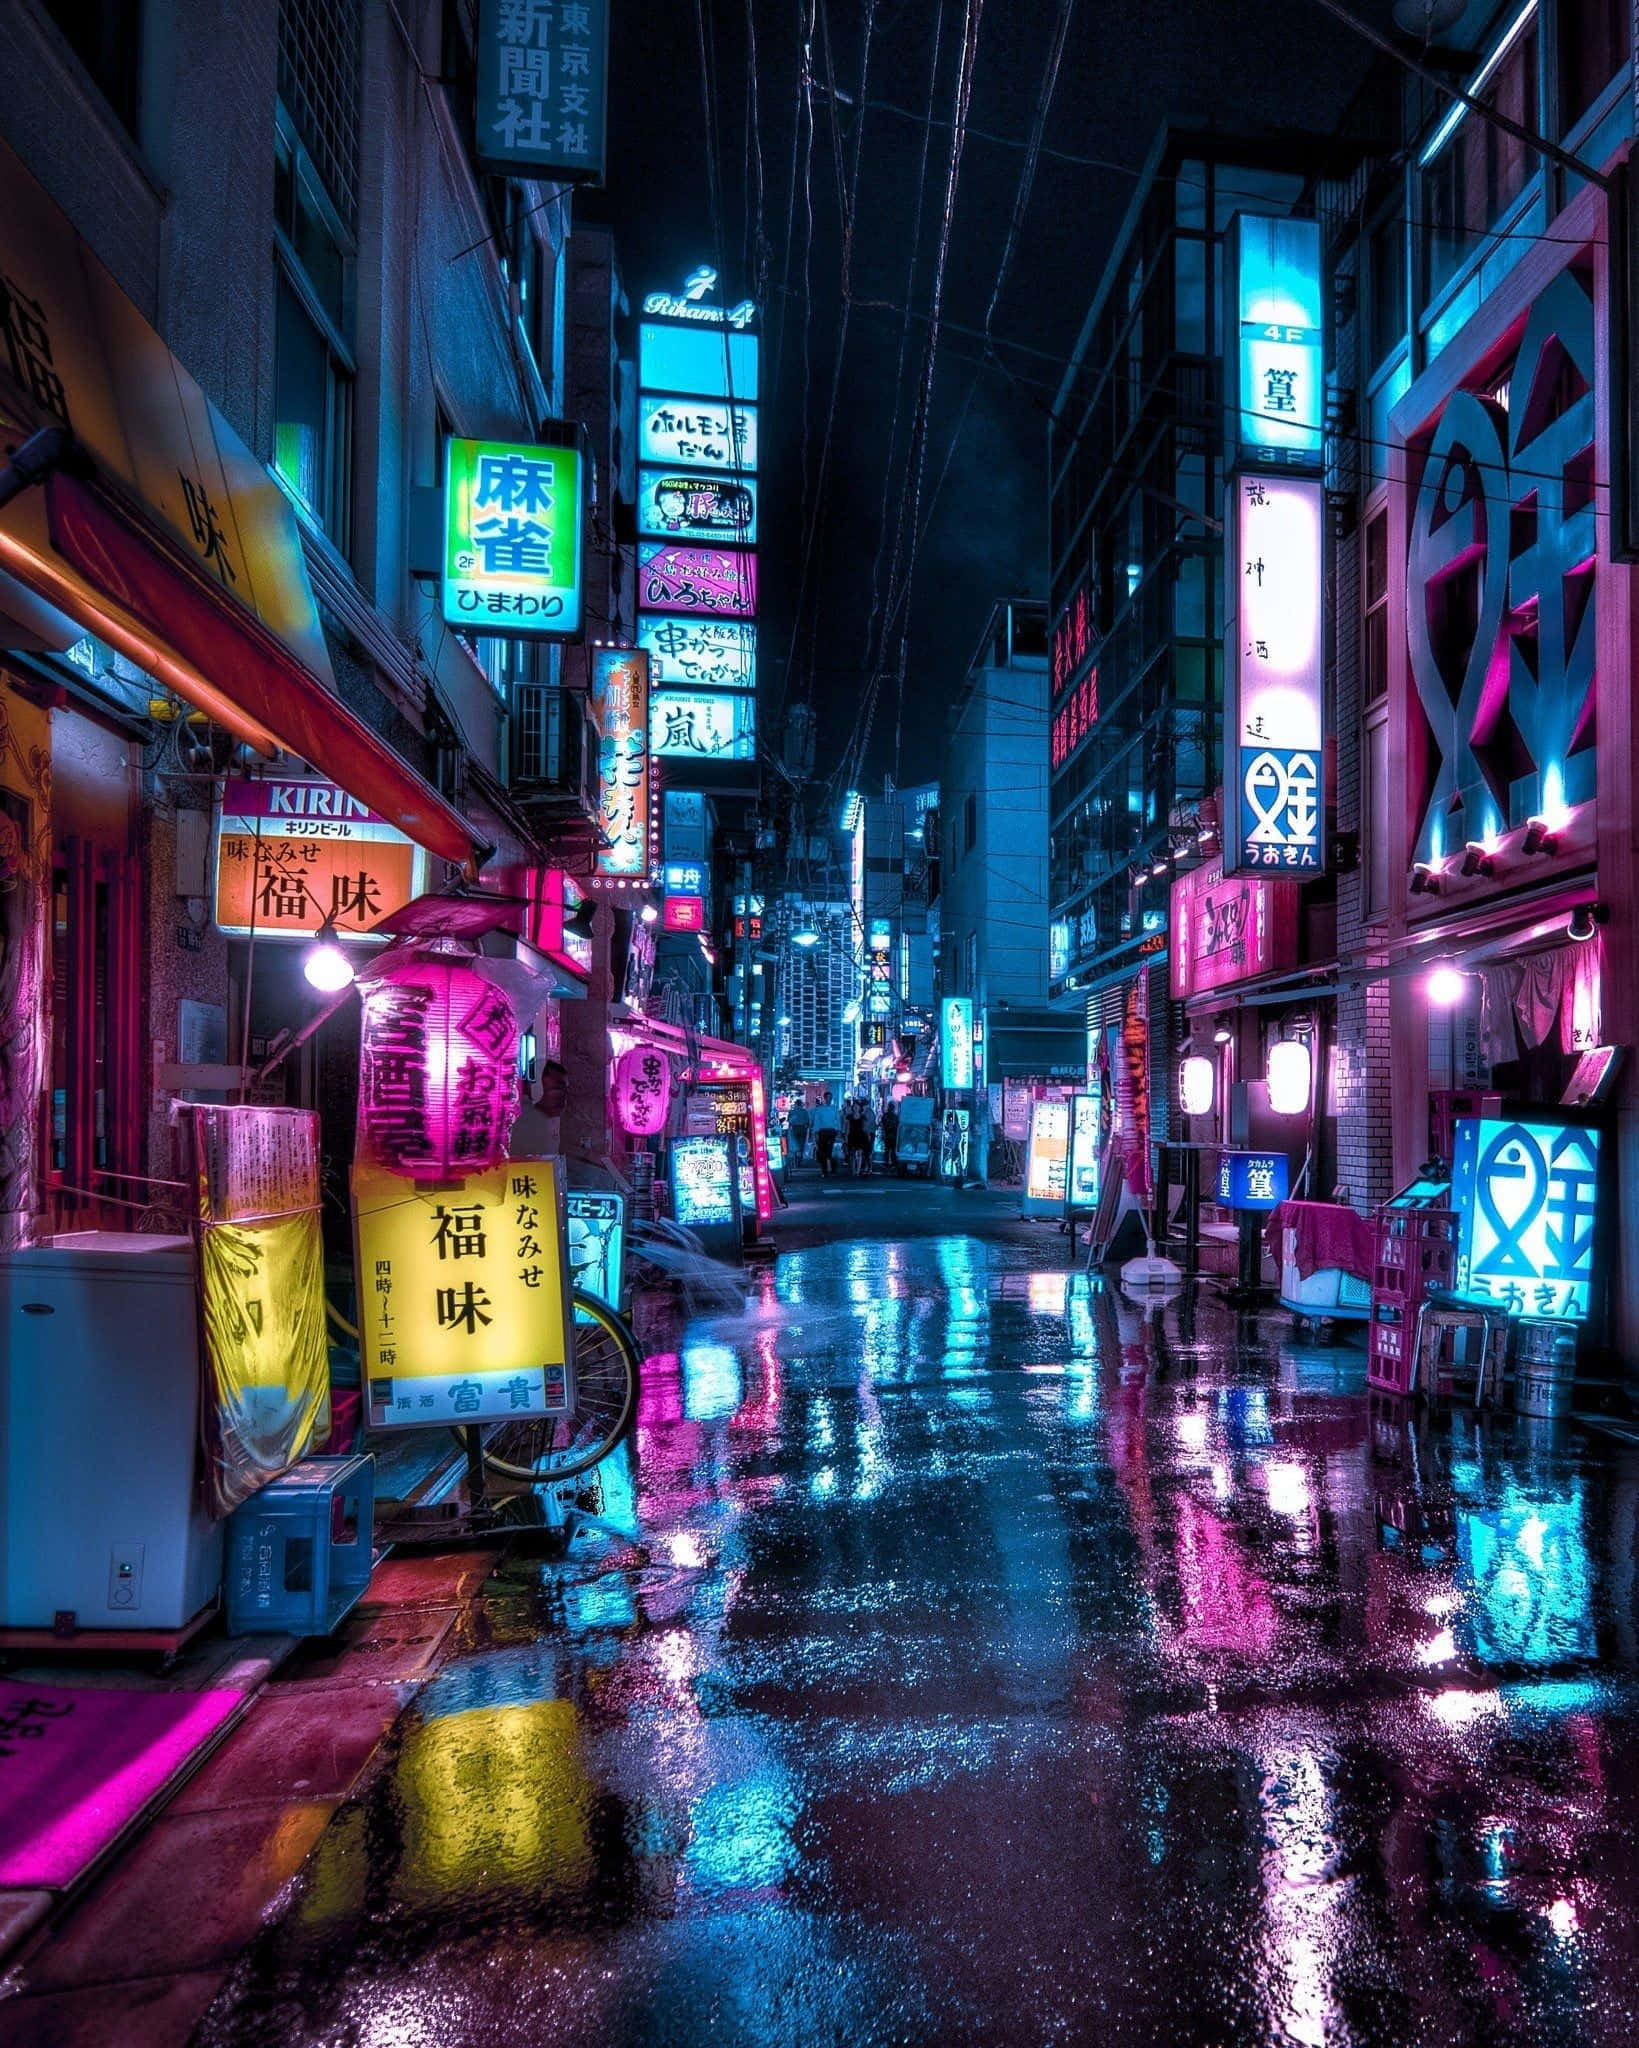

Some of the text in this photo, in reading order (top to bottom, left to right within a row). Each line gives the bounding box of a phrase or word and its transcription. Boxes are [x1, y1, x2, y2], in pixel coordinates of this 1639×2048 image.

[492, 0, 553, 150] 新聞社
[556, 2, 592, 154] 東京支社
[1264, 325, 1304, 343] 4F
[651, 410, 730, 436] ホルモン
[474, 454, 555, 577] 麻雀
[458, 555, 475, 569] 2F
[457, 589, 565, 618] ひまわり
[654, 705, 708, 754] 嵐
[285, 820, 352, 838] キリンビール
[226, 838, 321, 864] 味なみせ
[1245, 844, 1318, 867] うおきん
[257, 865, 383, 922] 福味
[1247, 1159, 1275, 1169] タカムラ
[512, 1175, 545, 1289] 味なみせ
[429, 1203, 494, 1336] 福味
